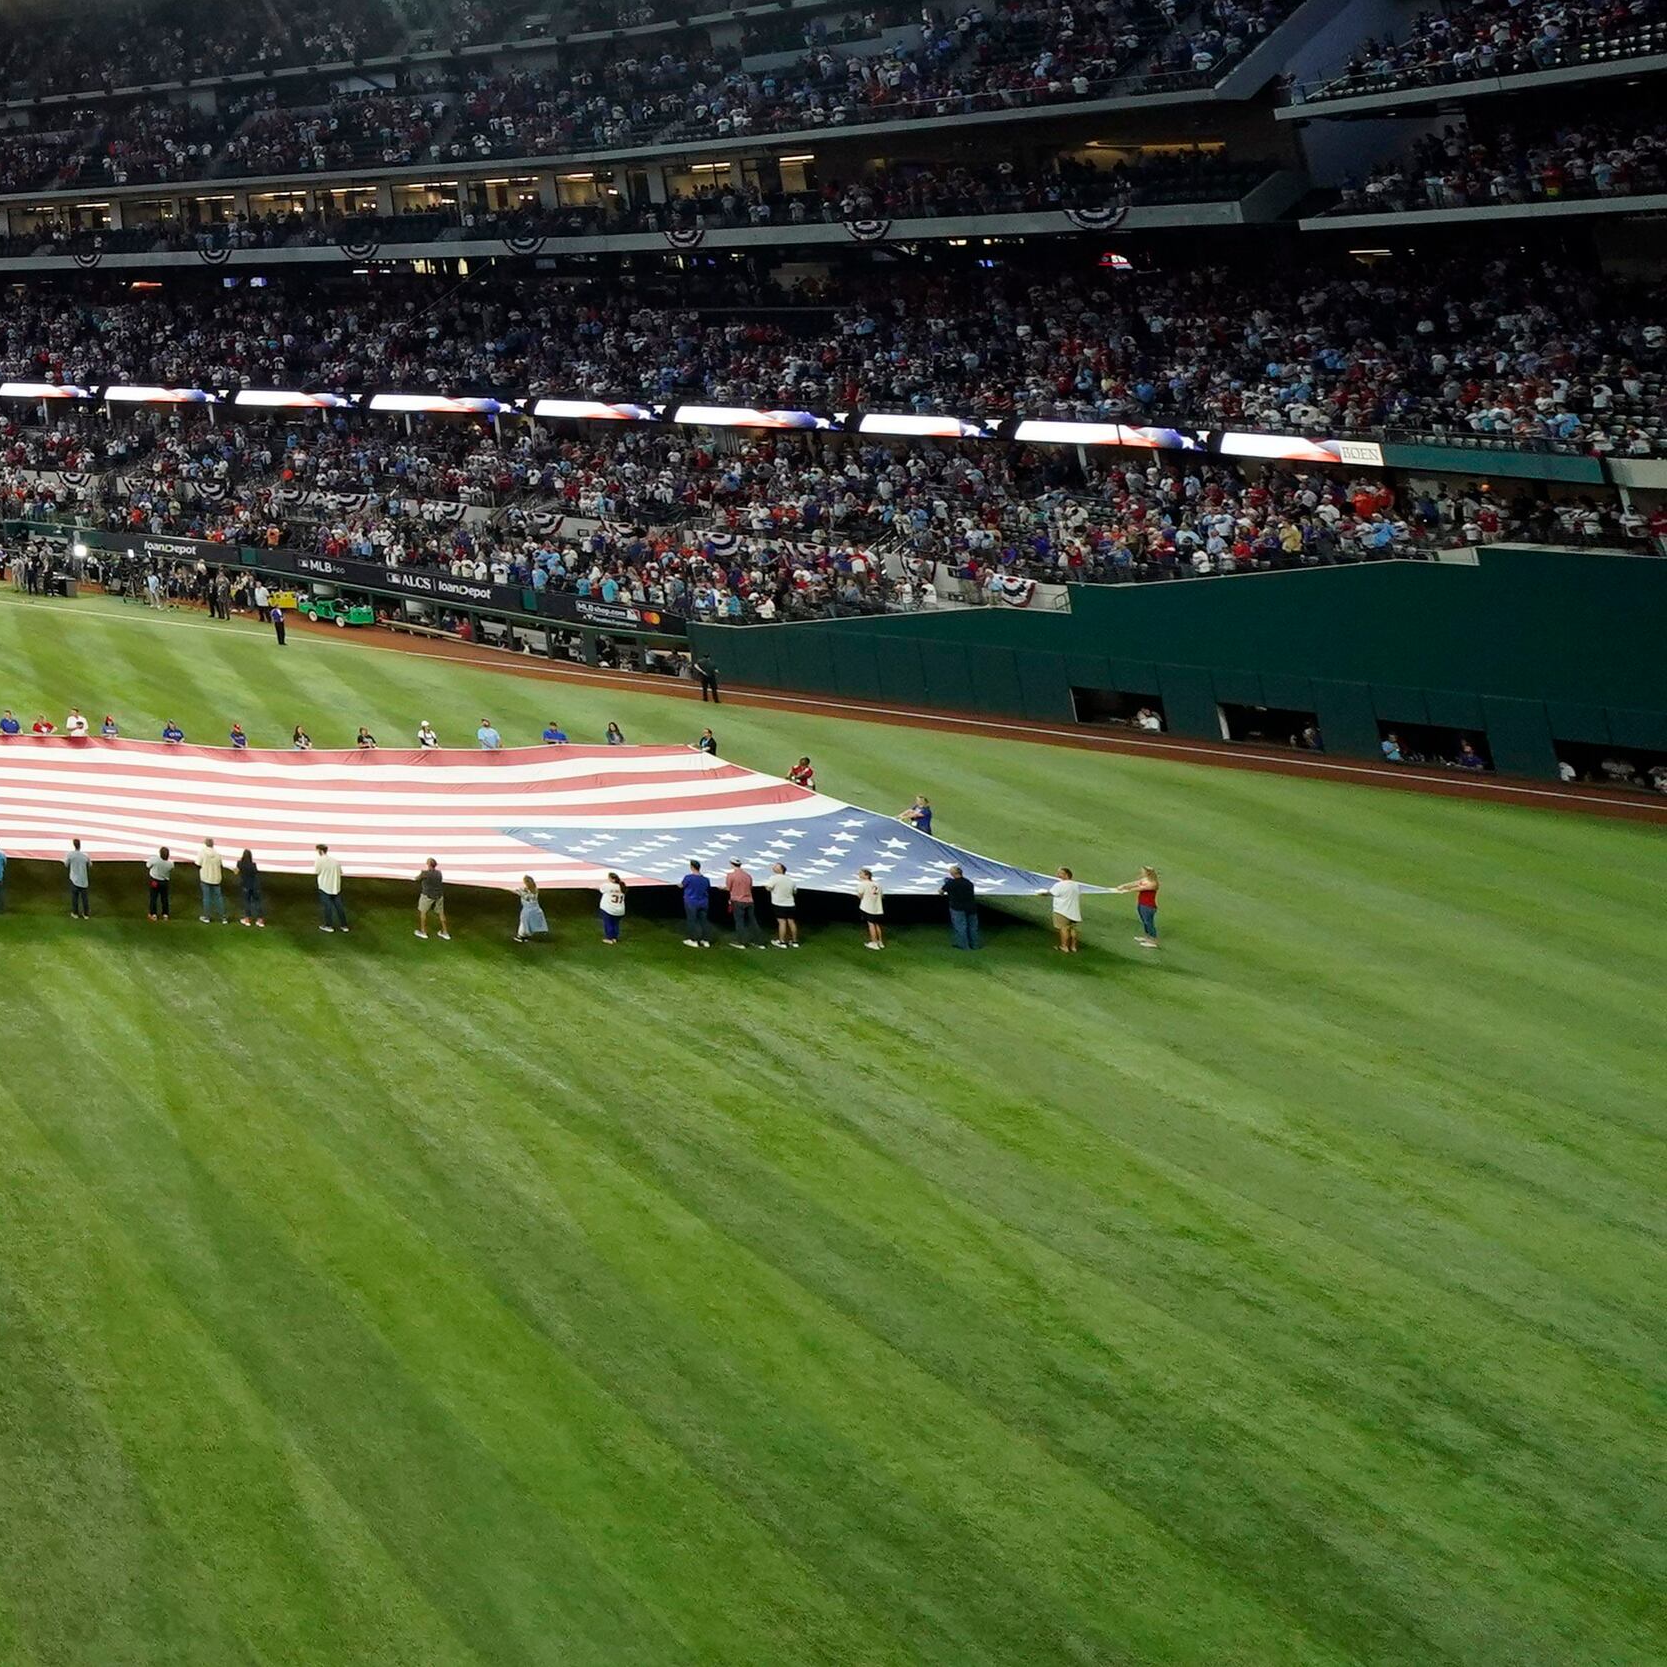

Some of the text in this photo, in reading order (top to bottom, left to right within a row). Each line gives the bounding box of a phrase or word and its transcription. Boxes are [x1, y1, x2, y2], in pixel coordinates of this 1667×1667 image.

[144, 540, 197, 555] loanDepot
[309, 559, 332, 573] MLB
[401, 574, 492, 600] ALCS loanDepot
